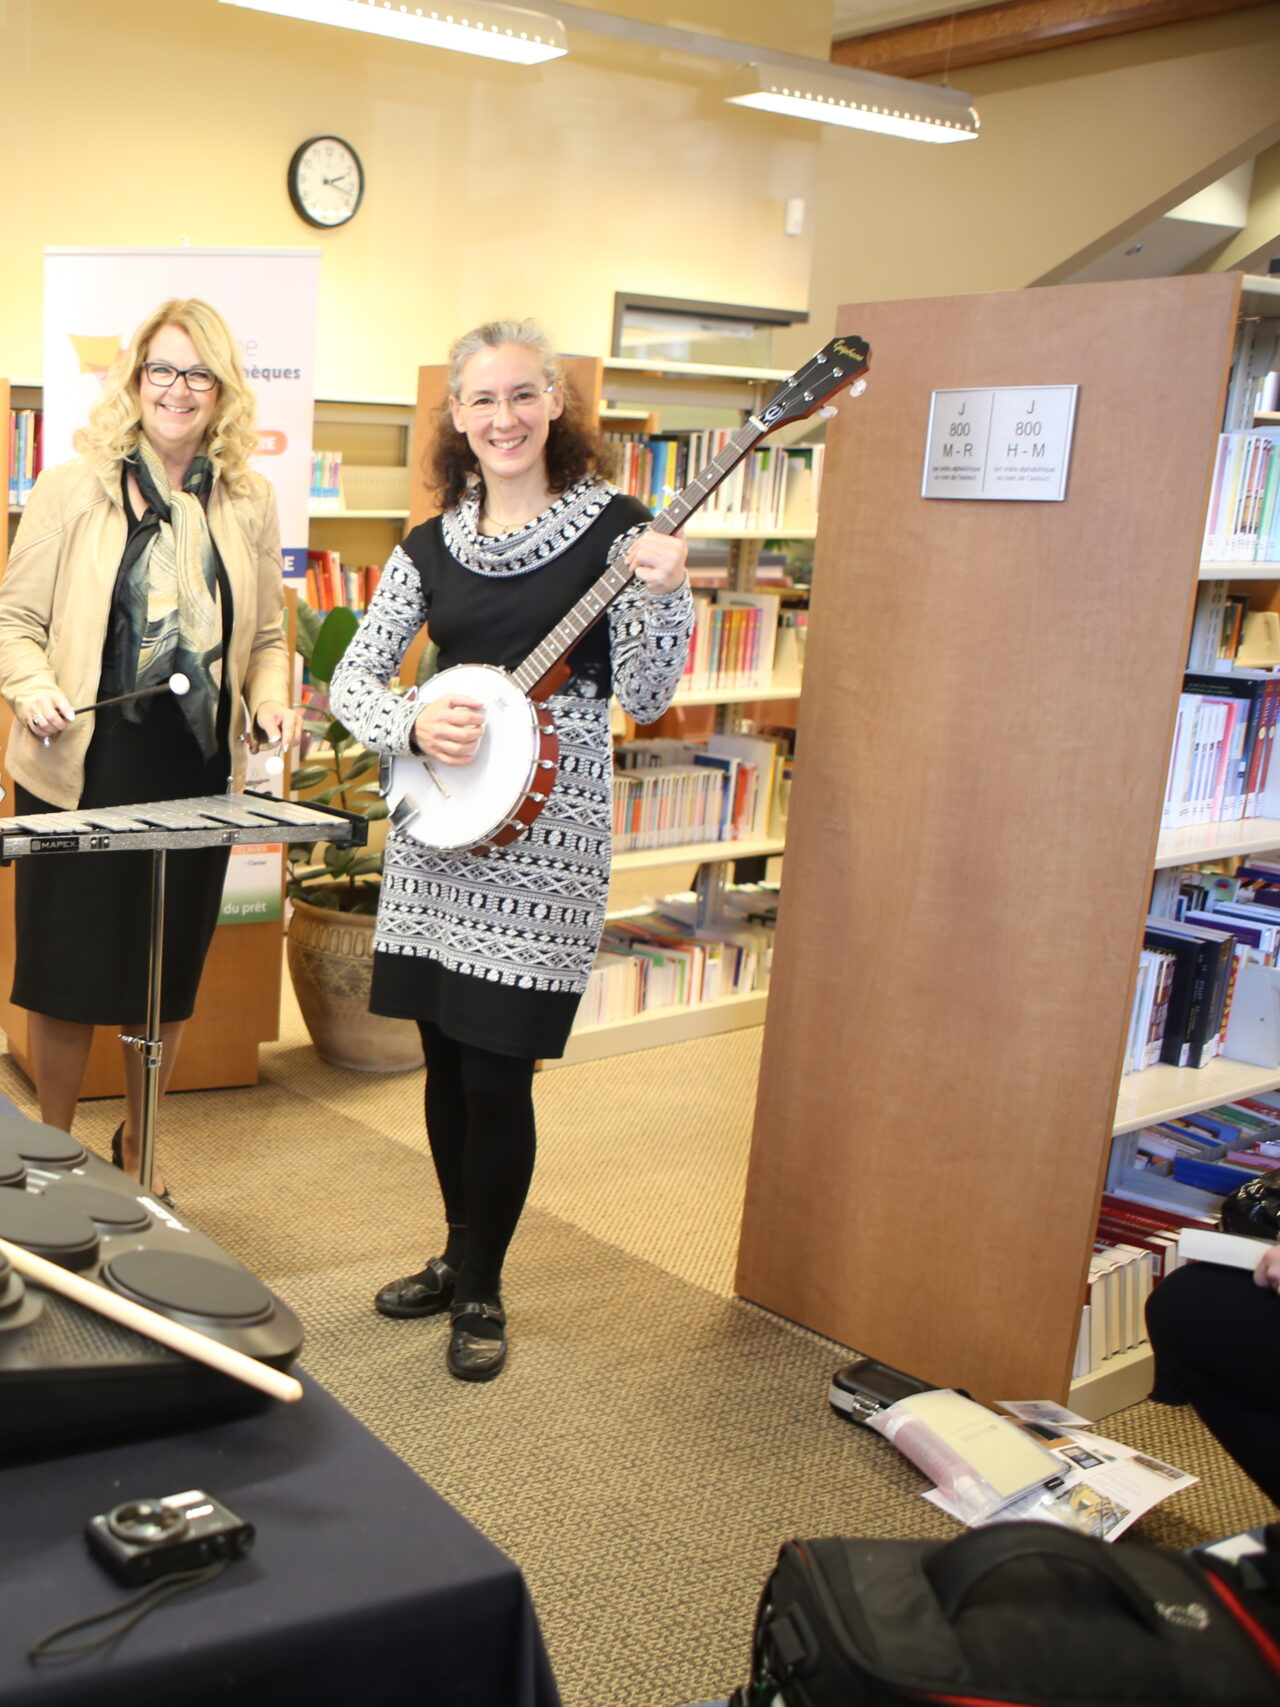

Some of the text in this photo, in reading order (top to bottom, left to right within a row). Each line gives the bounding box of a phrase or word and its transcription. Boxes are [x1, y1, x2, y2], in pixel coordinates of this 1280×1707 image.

[958, 402, 966, 416] J
[1026, 400, 1035, 415] J
[949, 422, 971, 437] 800
[1015, 421, 1042, 437] 800
[41, 841, 76, 849] MAPEX
[223, 901, 268, 916] du prêt
